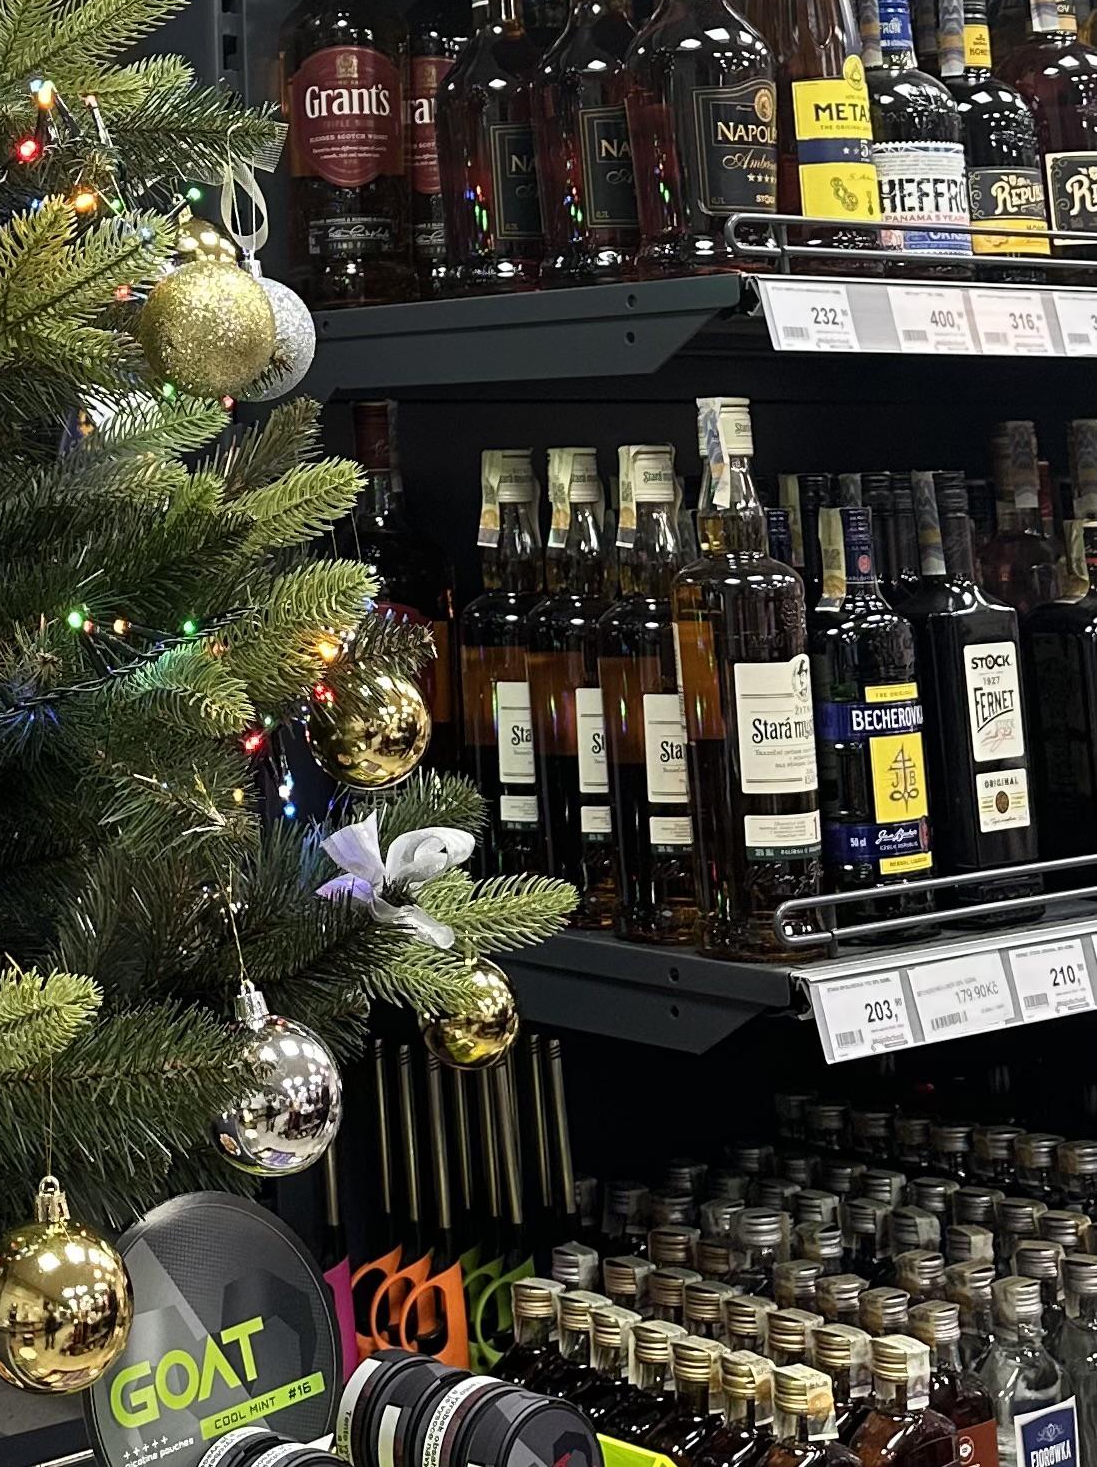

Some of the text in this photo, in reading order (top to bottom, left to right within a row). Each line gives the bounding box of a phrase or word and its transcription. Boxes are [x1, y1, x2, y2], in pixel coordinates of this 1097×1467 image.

[305, 83, 391, 119] Grant's
[884, 214, 933, 223] PANAMA
[811, 307, 845, 330] 232,
[930, 310, 961, 331] 400,
[1009, 312, 1040, 333] 316,
[971, 654, 1012, 670] STOCK
[973, 686, 1015, 729] FERNET
[511, 725, 532, 746] Sta
[752, 716, 793, 744] Stará
[660, 740, 683, 763] Sta
[891, 769, 917, 788] J B
[984, 775, 1020, 789] ORIGINAL
[850, 837, 859, 847] 50
[1050, 964, 1081, 987] 210,
[864, 999, 899, 1023] 203,
[110, 1316, 265, 1429] GOAT
[214, 1410, 247, 1430] COOL
[249, 1396, 277, 1418] MINT
[159, 1436, 195, 1458] pouches
